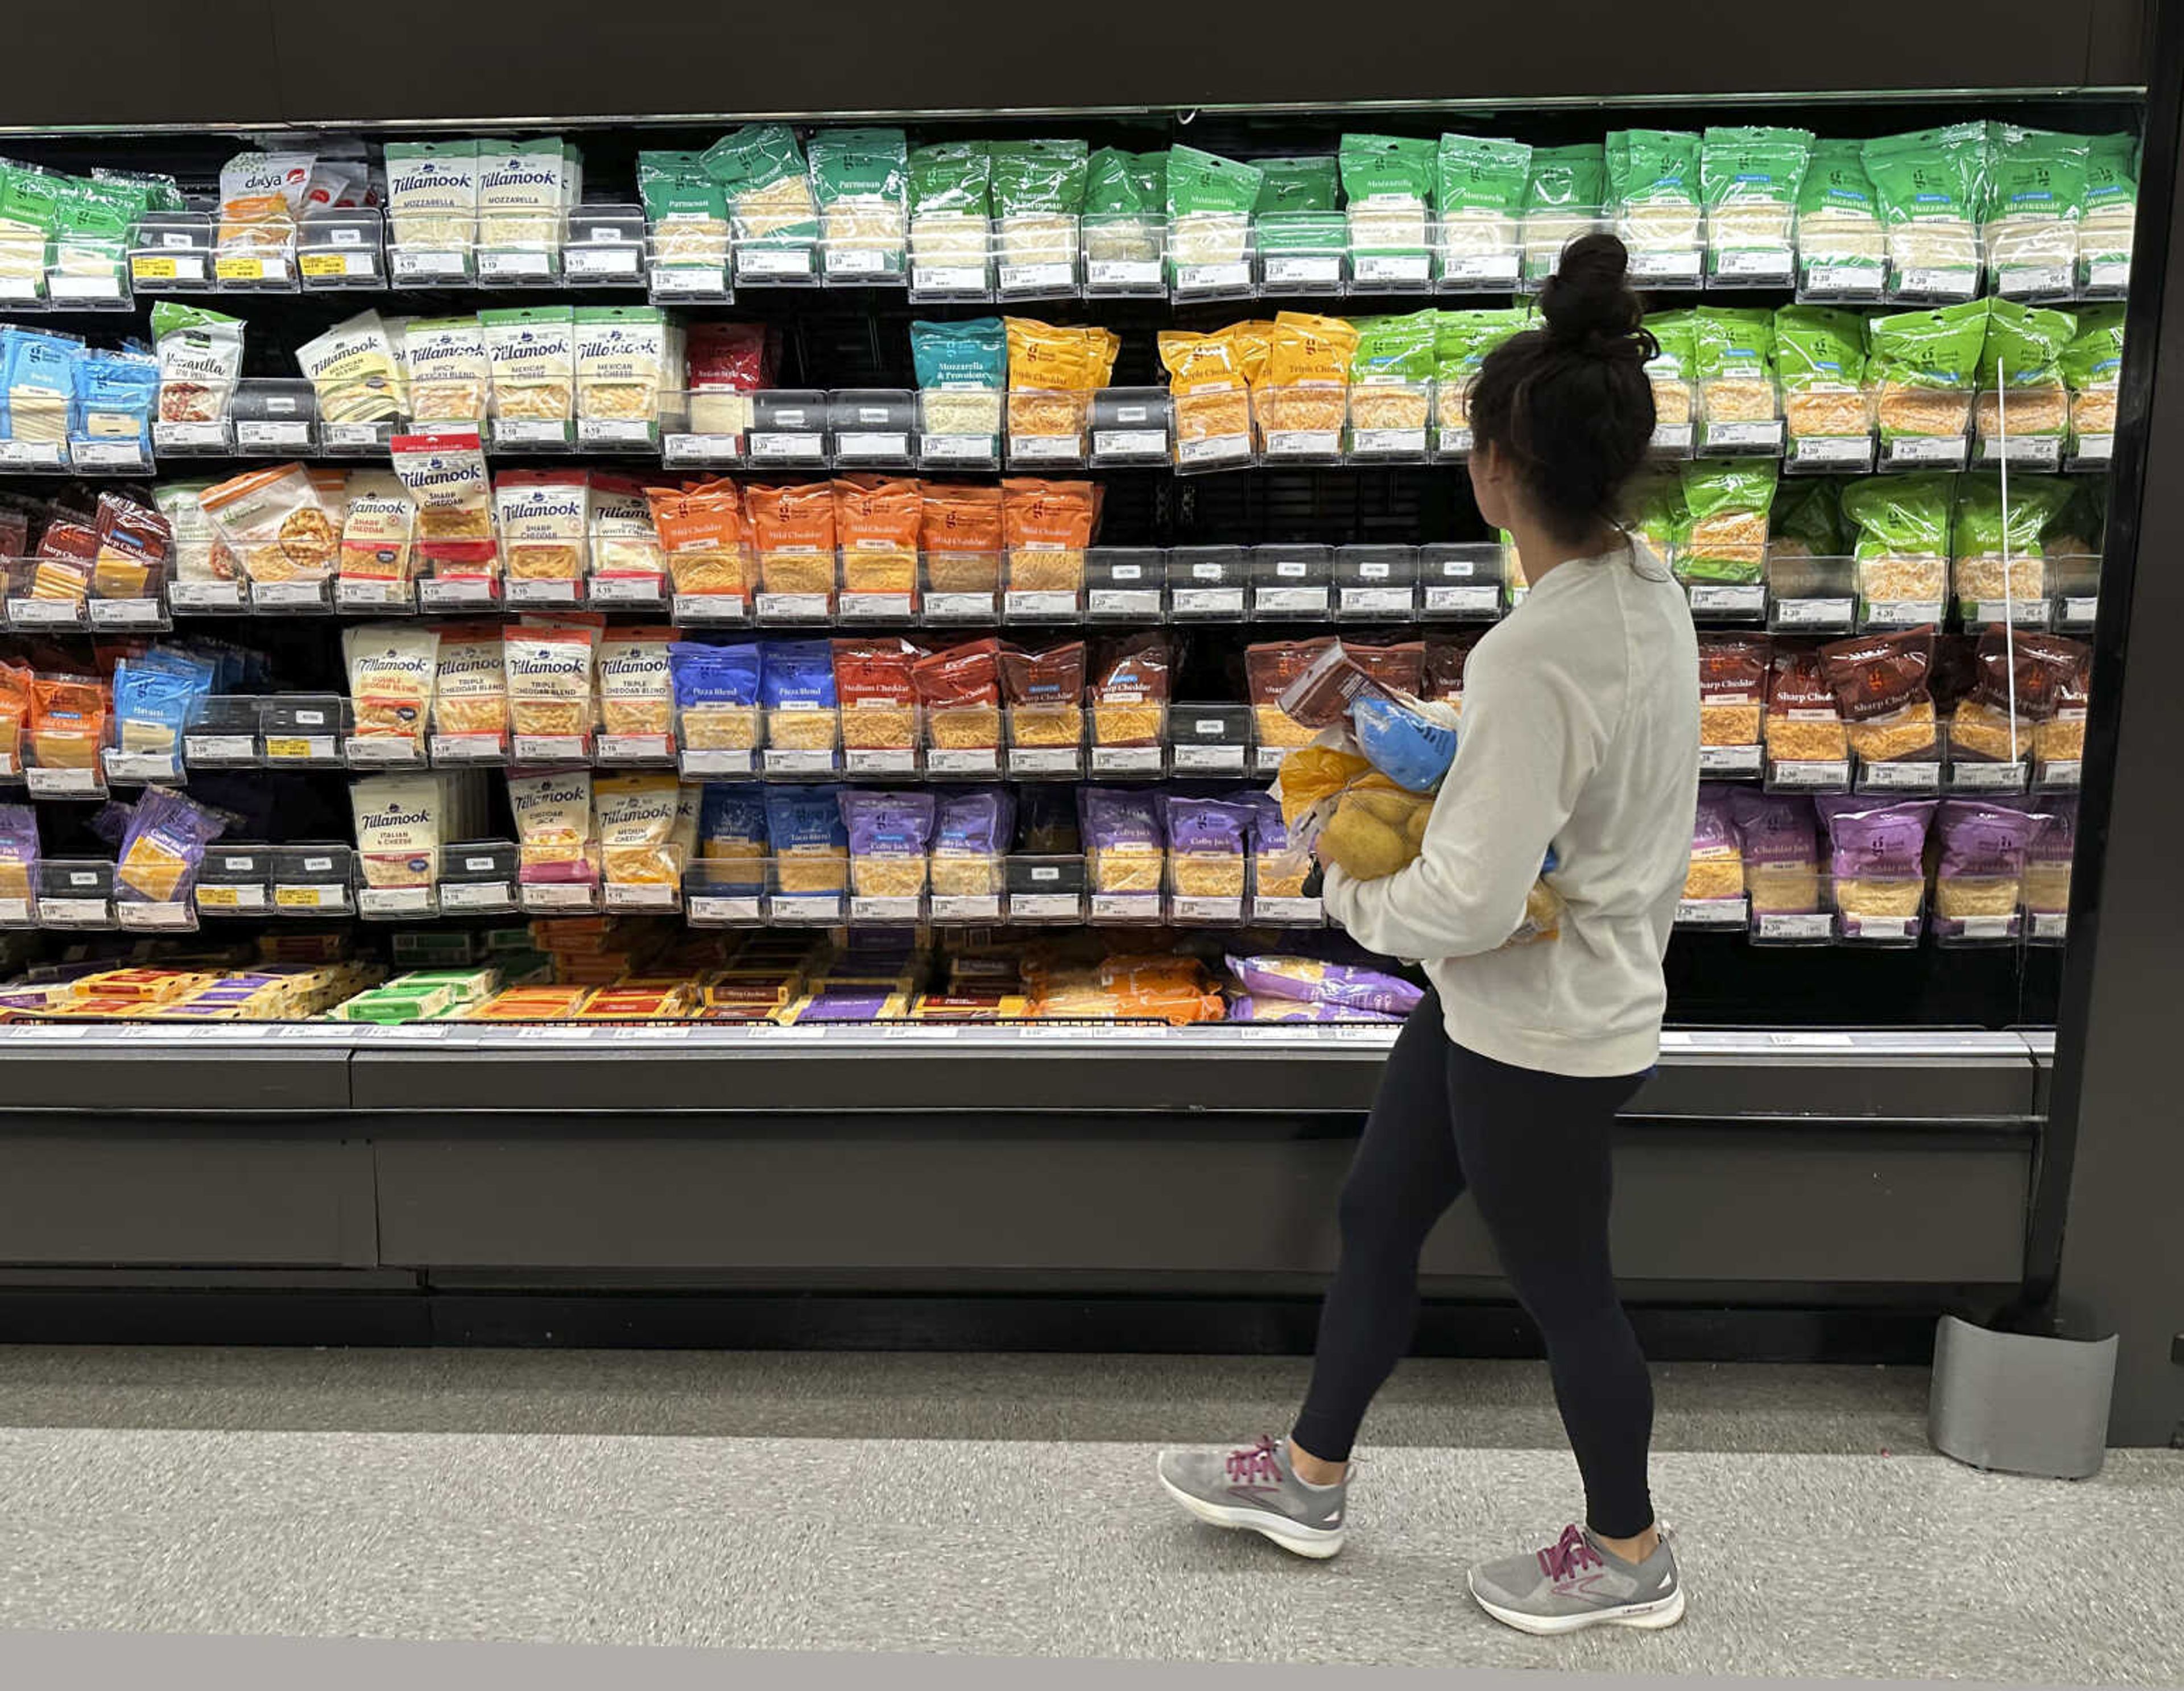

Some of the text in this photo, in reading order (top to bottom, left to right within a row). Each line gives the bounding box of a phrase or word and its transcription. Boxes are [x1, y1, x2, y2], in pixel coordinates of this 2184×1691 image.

[392, 173, 471, 194] Tillamook
[481, 169, 557, 191] Tillamook
[839, 180, 880, 189] Parmesan
[403, 197, 455, 208] MOZZARELLA
[488, 196, 539, 204] MOZZARELLA
[491, 338, 569, 361] Tillamook
[311, 337, 379, 376] Tillamook
[410, 344, 485, 366] Tillamook
[938, 362, 984, 371] Mozzarella
[1289, 365, 1314, 374] Triple
[400, 465, 481, 488] Tillamook
[424, 498, 464, 508] CHEDDAR
[503, 501, 581, 522] Tillamook
[691, 524, 722, 534] Cheddar
[868, 525, 903, 534] Cheddar
[786, 531, 823, 539] Cheddar
[359, 658, 427, 673] Tillamook
[510, 659, 584, 675] Tillamook
[441, 685, 478, 694] CHEDDAR
[876, 684, 909, 692] Cheddar
[1118, 683, 1151, 692] Cheddar
[1264, 685, 1285, 694] Shar
[1699, 679, 1757, 691] harp Cheddar
[693, 687, 737, 696] Pizza Blend
[779, 687, 822, 696] Pizza Blend
[1039, 692, 1073, 701] Cheddar
[1777, 692, 1835, 703] Sharp Ched
[1854, 699, 1883, 712] Sharp
[515, 786, 585, 812] Tillamook
[362, 809, 430, 830] Tillamook
[601, 803, 672, 826] Tillamook
[1190, 837, 1213, 846] Colby
[870, 842, 910, 852] Colby Jack
[1755, 845, 1793, 854] Cheddar
